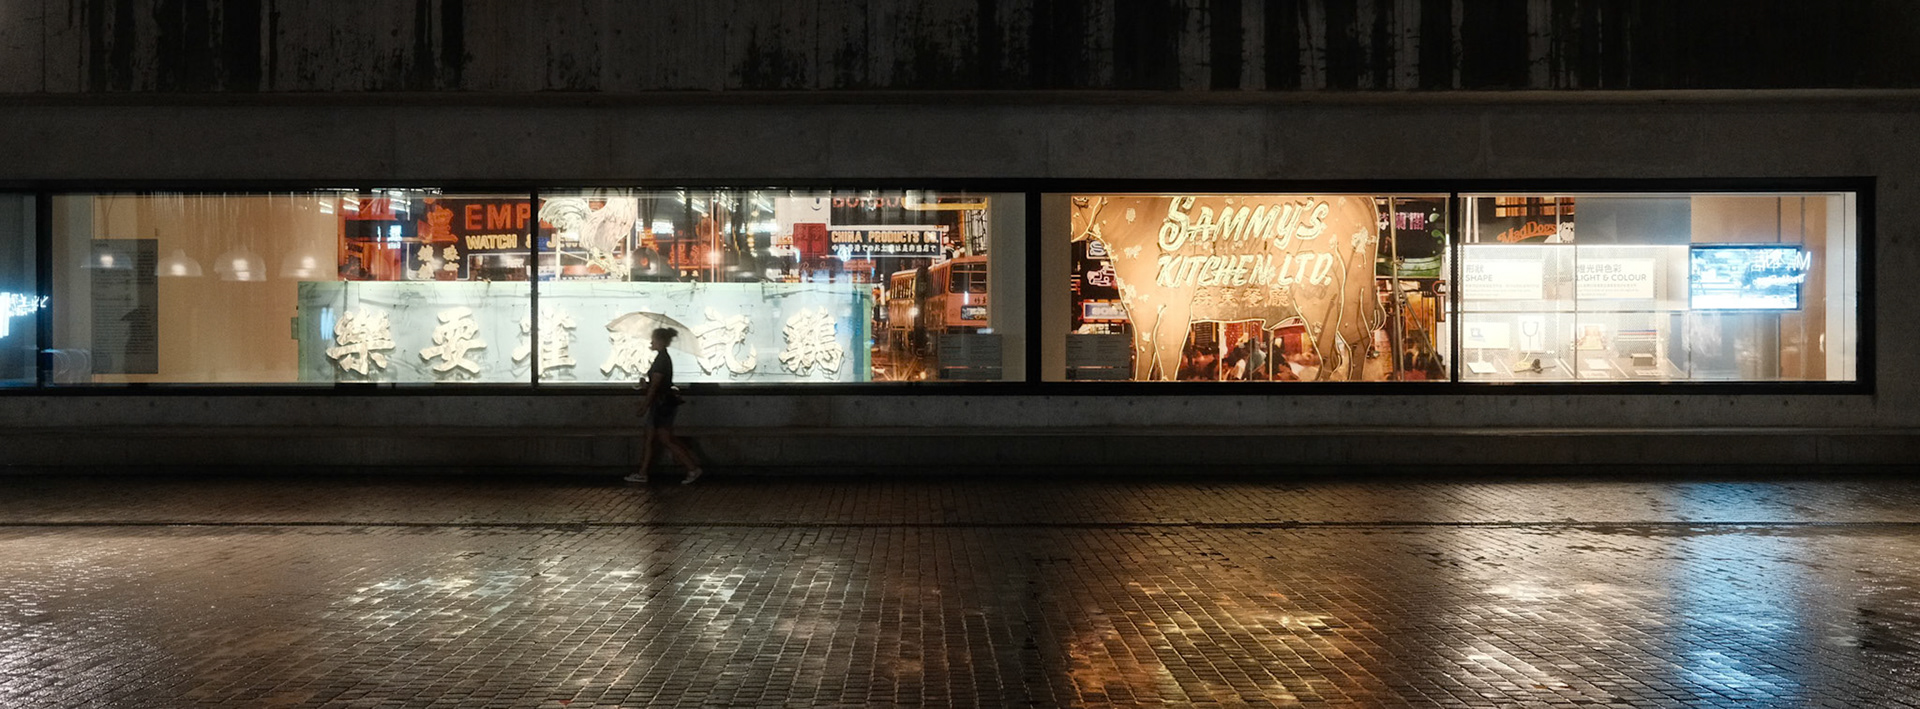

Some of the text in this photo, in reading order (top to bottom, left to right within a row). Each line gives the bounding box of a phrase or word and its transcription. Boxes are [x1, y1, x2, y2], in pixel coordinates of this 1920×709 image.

[465, 233, 518, 250] WATCH
[831, 231, 863, 243] CHINA
[868, 231, 919, 243] PRODUCTS
[1156, 253, 1275, 288] KITCHEN
[1465, 274, 1493, 282] SHAPE
[1611, 273, 1648, 282] COLOUR
